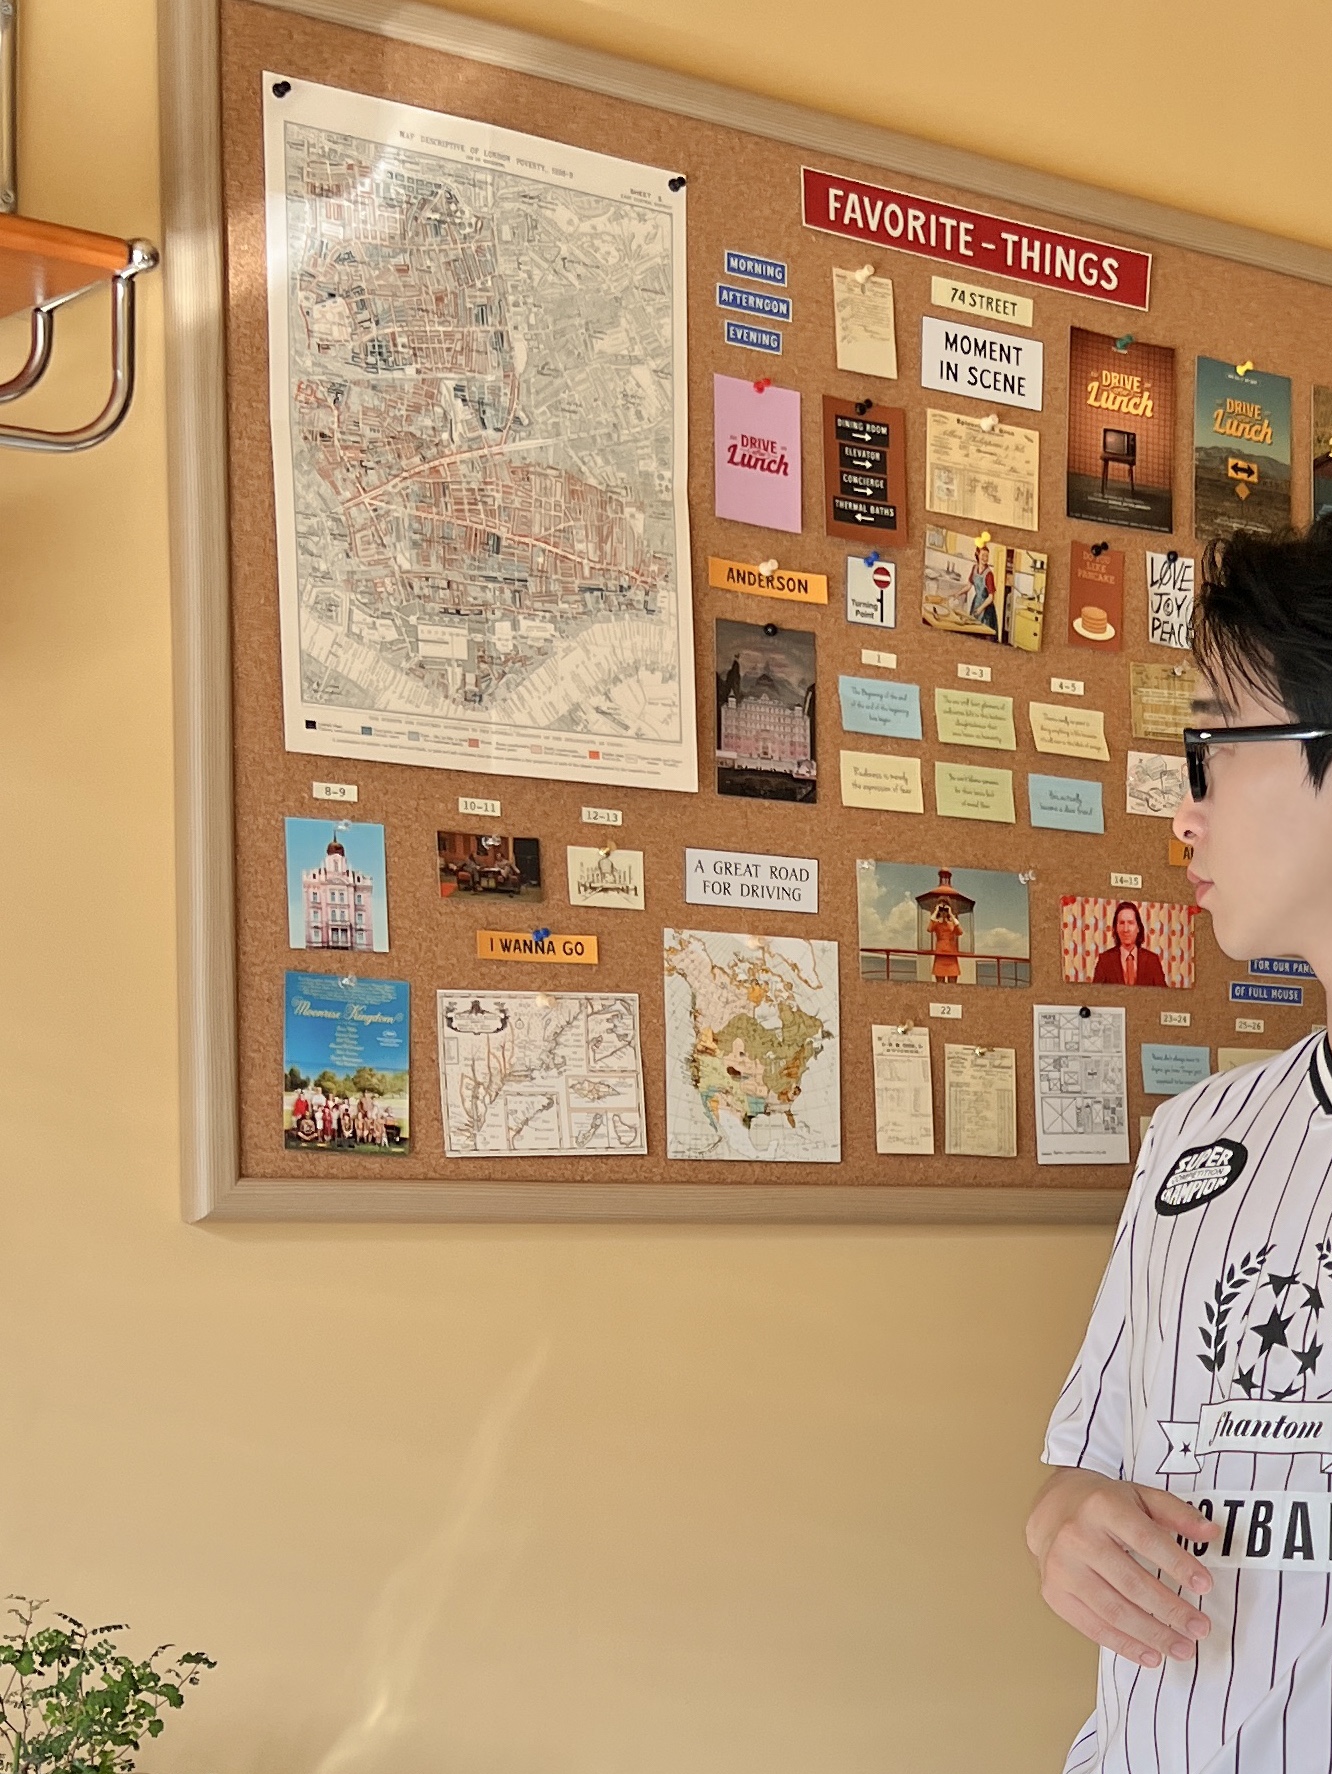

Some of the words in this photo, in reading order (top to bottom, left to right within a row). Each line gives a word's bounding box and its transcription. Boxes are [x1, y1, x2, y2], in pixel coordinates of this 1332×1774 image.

[729, 257, 783, 280] MORNING
[721, 290, 787, 315] AFTERNOON
[950, 287, 966, 304] 74
[968, 292, 1018, 317] STREET
[729, 327, 778, 348] EVENING
[944, 331, 1023, 367] MOMENT
[939, 360, 958, 383] IN
[967, 366, 1027, 397] SCENE
[1102, 371, 1142, 392] DRIVE
[1087, 382, 1153, 418] Lunch
[1226, 399, 1262, 420] DRIVE
[837, 418, 864, 431] DINING
[866, 422, 888, 435] ROOM
[1213, 409, 1273, 445] Lunch
[741, 434, 777, 454] DRIVE
[845, 447, 881, 461] ELEVATOR
[727, 443, 789, 477] Lunch
[843, 473, 884, 489] CONCIERGE
[835, 499, 867, 514] THERMAL
[869, 503, 894, 517] BATHS
[727, 567, 808, 595] ANDERSON
[851, 598, 878, 613] Turning
[856, 609, 875, 620] Point
[463, 800, 497, 814] 10-11
[586, 810, 619, 824] 12-13
[694, 859, 705, 874] A
[713, 861, 761, 878] GREAT
[769, 865, 810, 882] ROAD
[702, 880, 732, 896] FOR
[740, 883, 802, 902] DRIVING
[490, 937, 495, 952] I
[499, 938, 557, 956] WANNA
[562, 941, 585, 956] GO
[1253, 960, 1270, 972] FOR
[1272, 961, 1290, 973] OUR
[1234, 986, 1246, 996] OF
[1248, 988, 1268, 998] FULL
[1271, 989, 1299, 1000] HOUSE
[940, 1006, 951, 1015] 22
[1175, 1146, 1233, 1174] SUPER
[1161, 1177, 1228, 1205] CHAMPION
